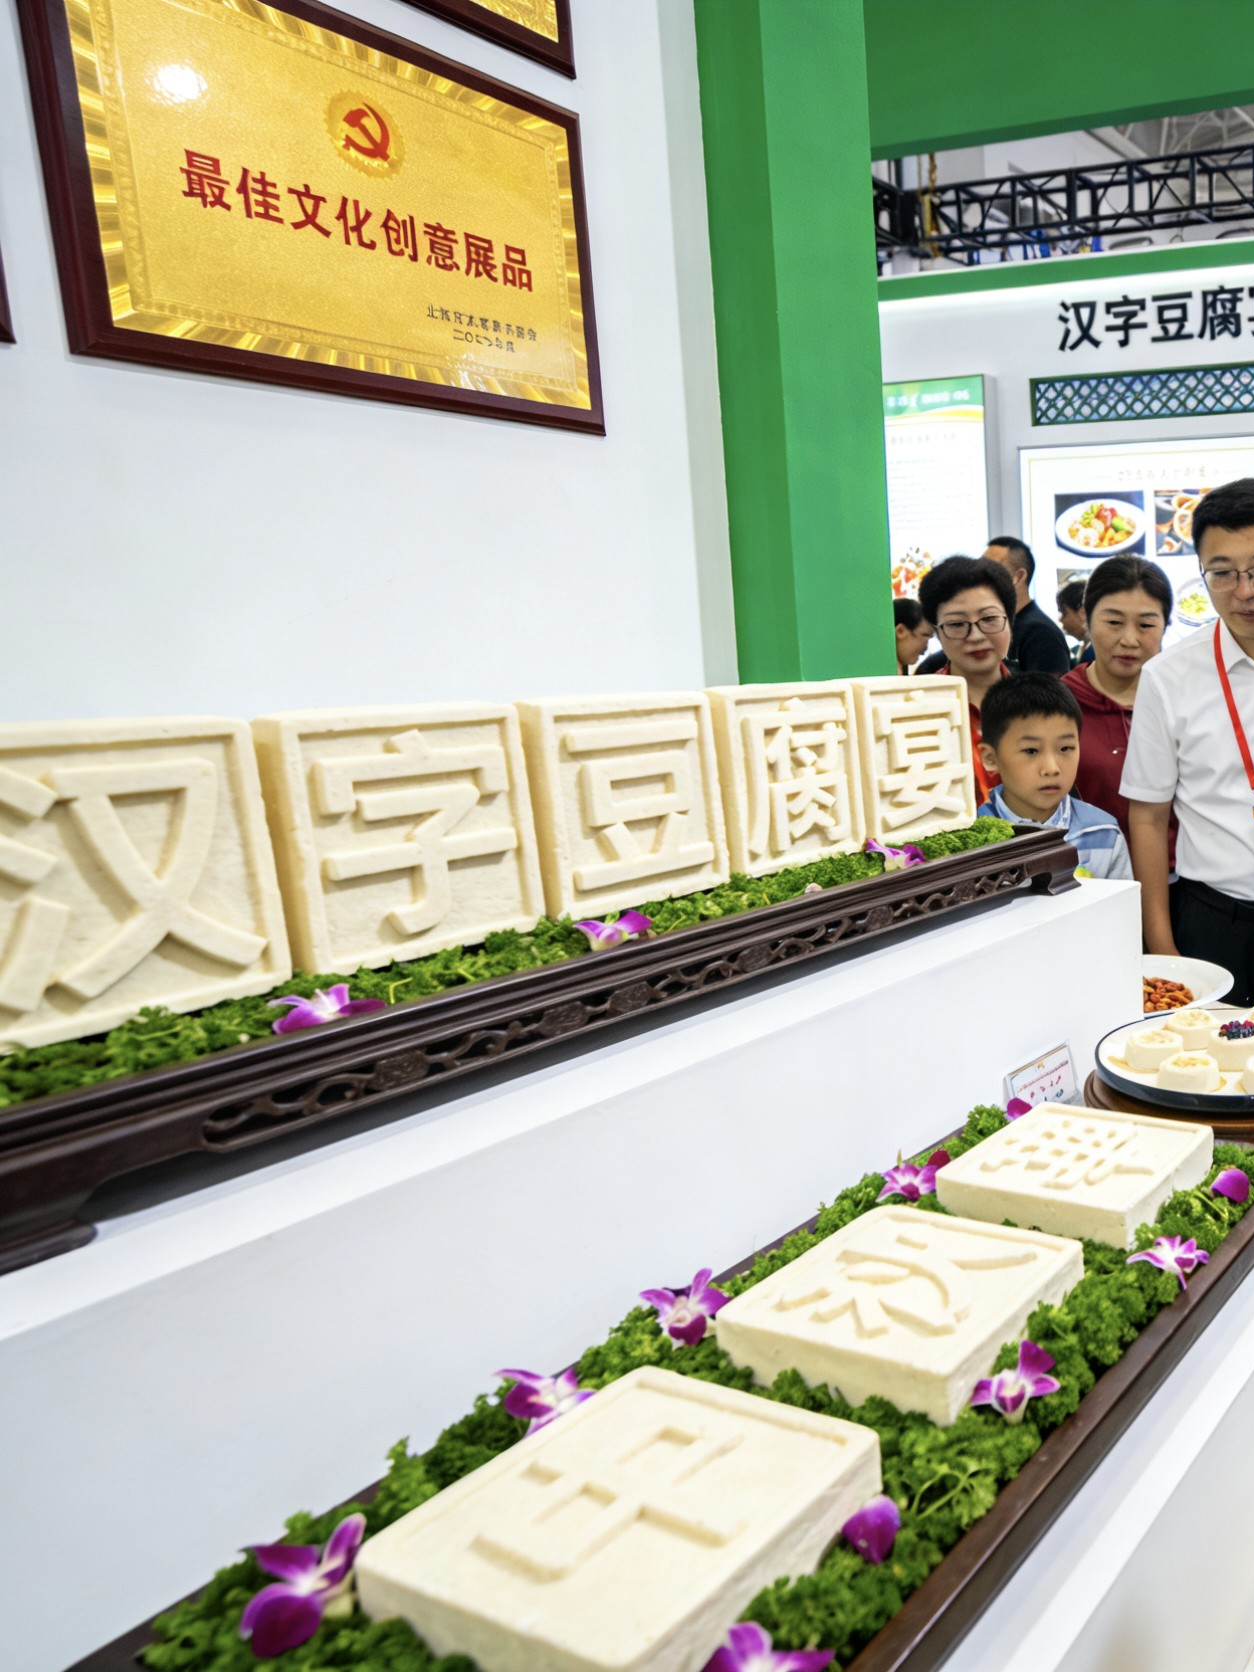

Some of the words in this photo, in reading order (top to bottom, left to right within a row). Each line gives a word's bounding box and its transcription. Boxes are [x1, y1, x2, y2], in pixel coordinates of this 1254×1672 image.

[180, 148, 533, 292] 最佳文化创意展品
